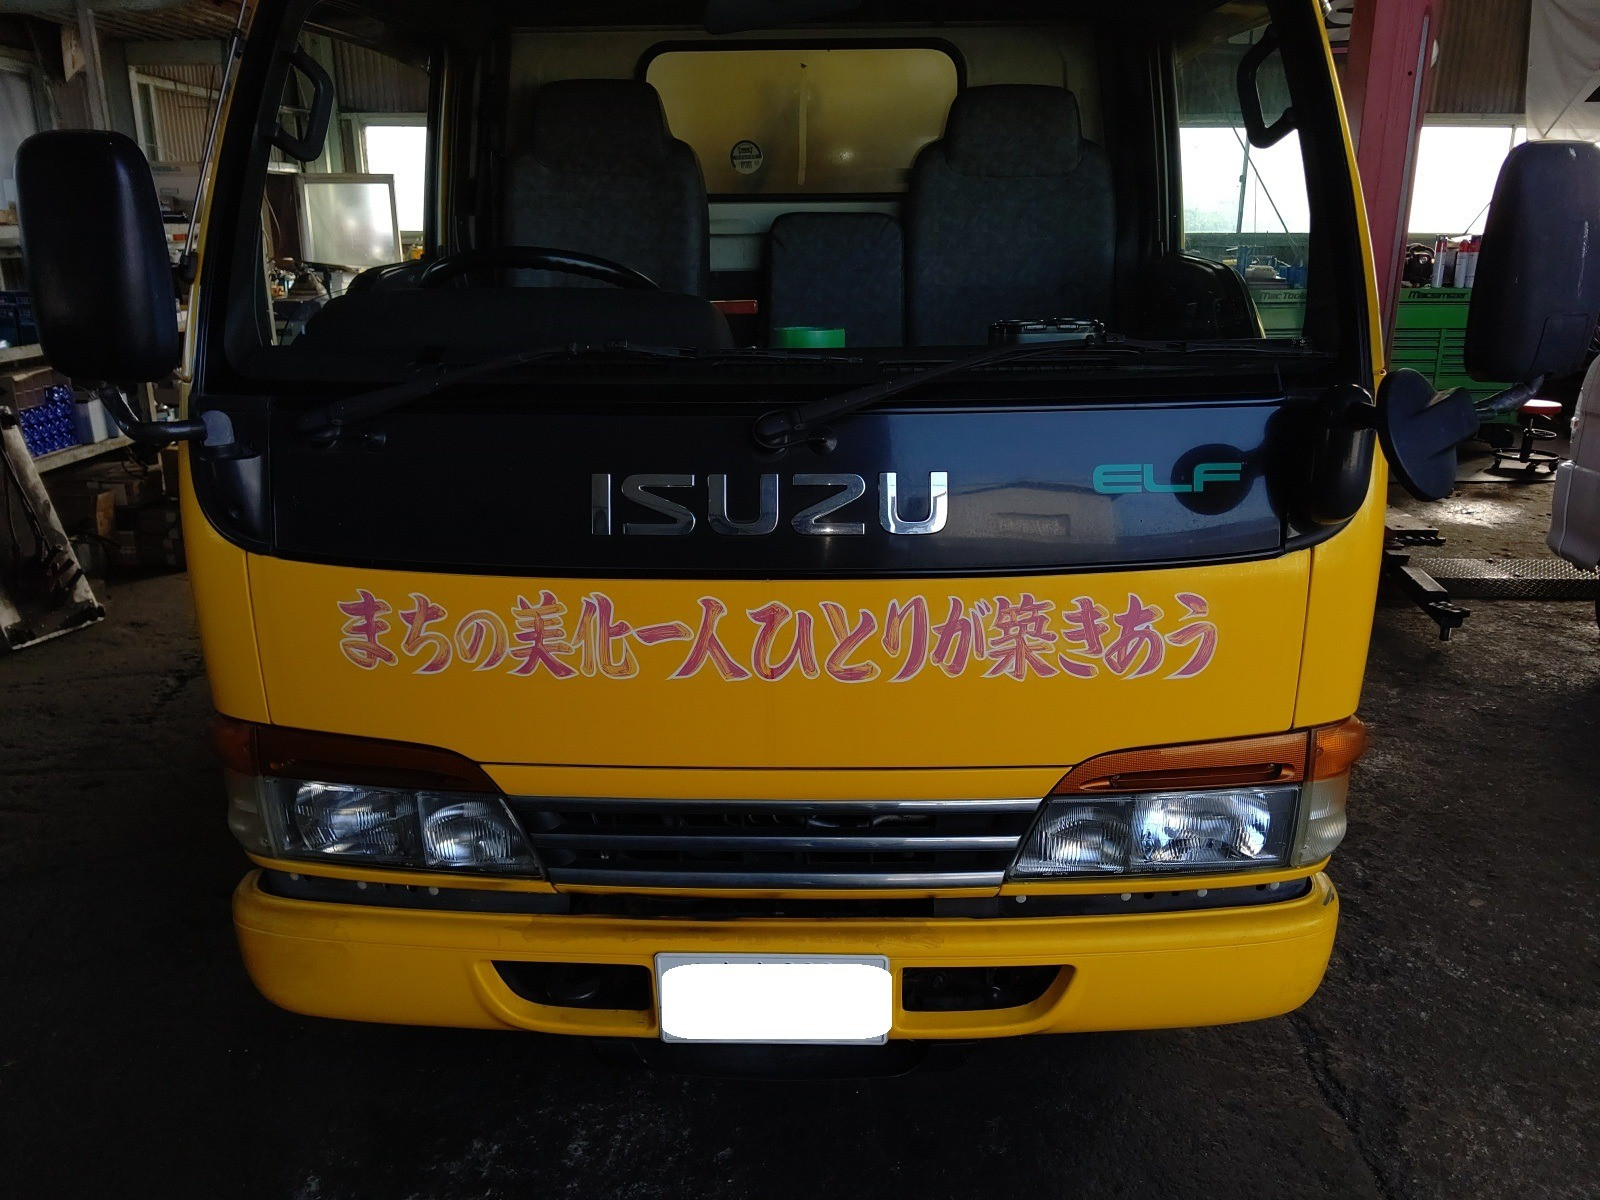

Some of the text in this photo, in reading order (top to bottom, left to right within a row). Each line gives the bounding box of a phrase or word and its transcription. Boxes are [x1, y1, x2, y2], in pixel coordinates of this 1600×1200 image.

[1408, 290, 1468, 299] Macsimizer
[1092, 462, 1242, 494] ELF
[591, 471, 949, 536] ISUZU
[337, 588, 1220, 684] まちの美化一人ひとりが築きあう
